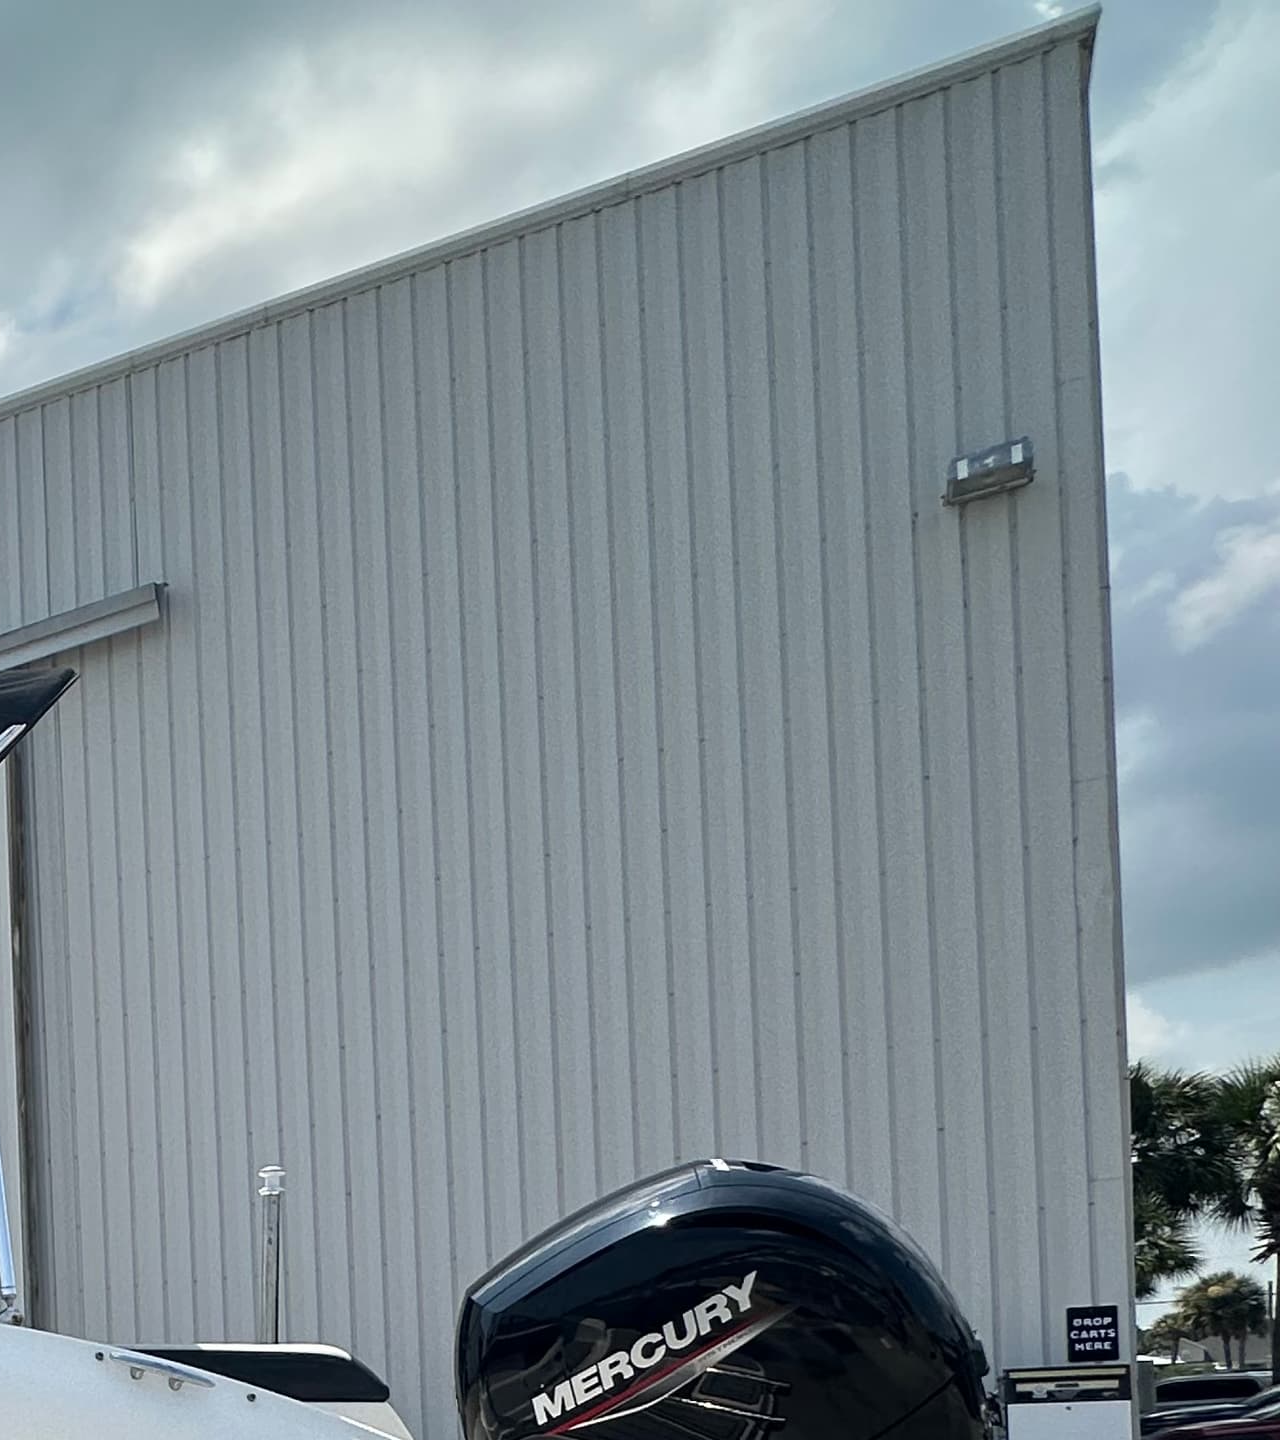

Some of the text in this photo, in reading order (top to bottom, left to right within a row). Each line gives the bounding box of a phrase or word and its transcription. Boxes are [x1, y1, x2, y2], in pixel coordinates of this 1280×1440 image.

[1072, 1316, 1112, 1327] DROP
[1070, 1328, 1116, 1339] CARTS
[531, 1270, 758, 1426] MERCURY
[1074, 1341, 1113, 1351] HERE
